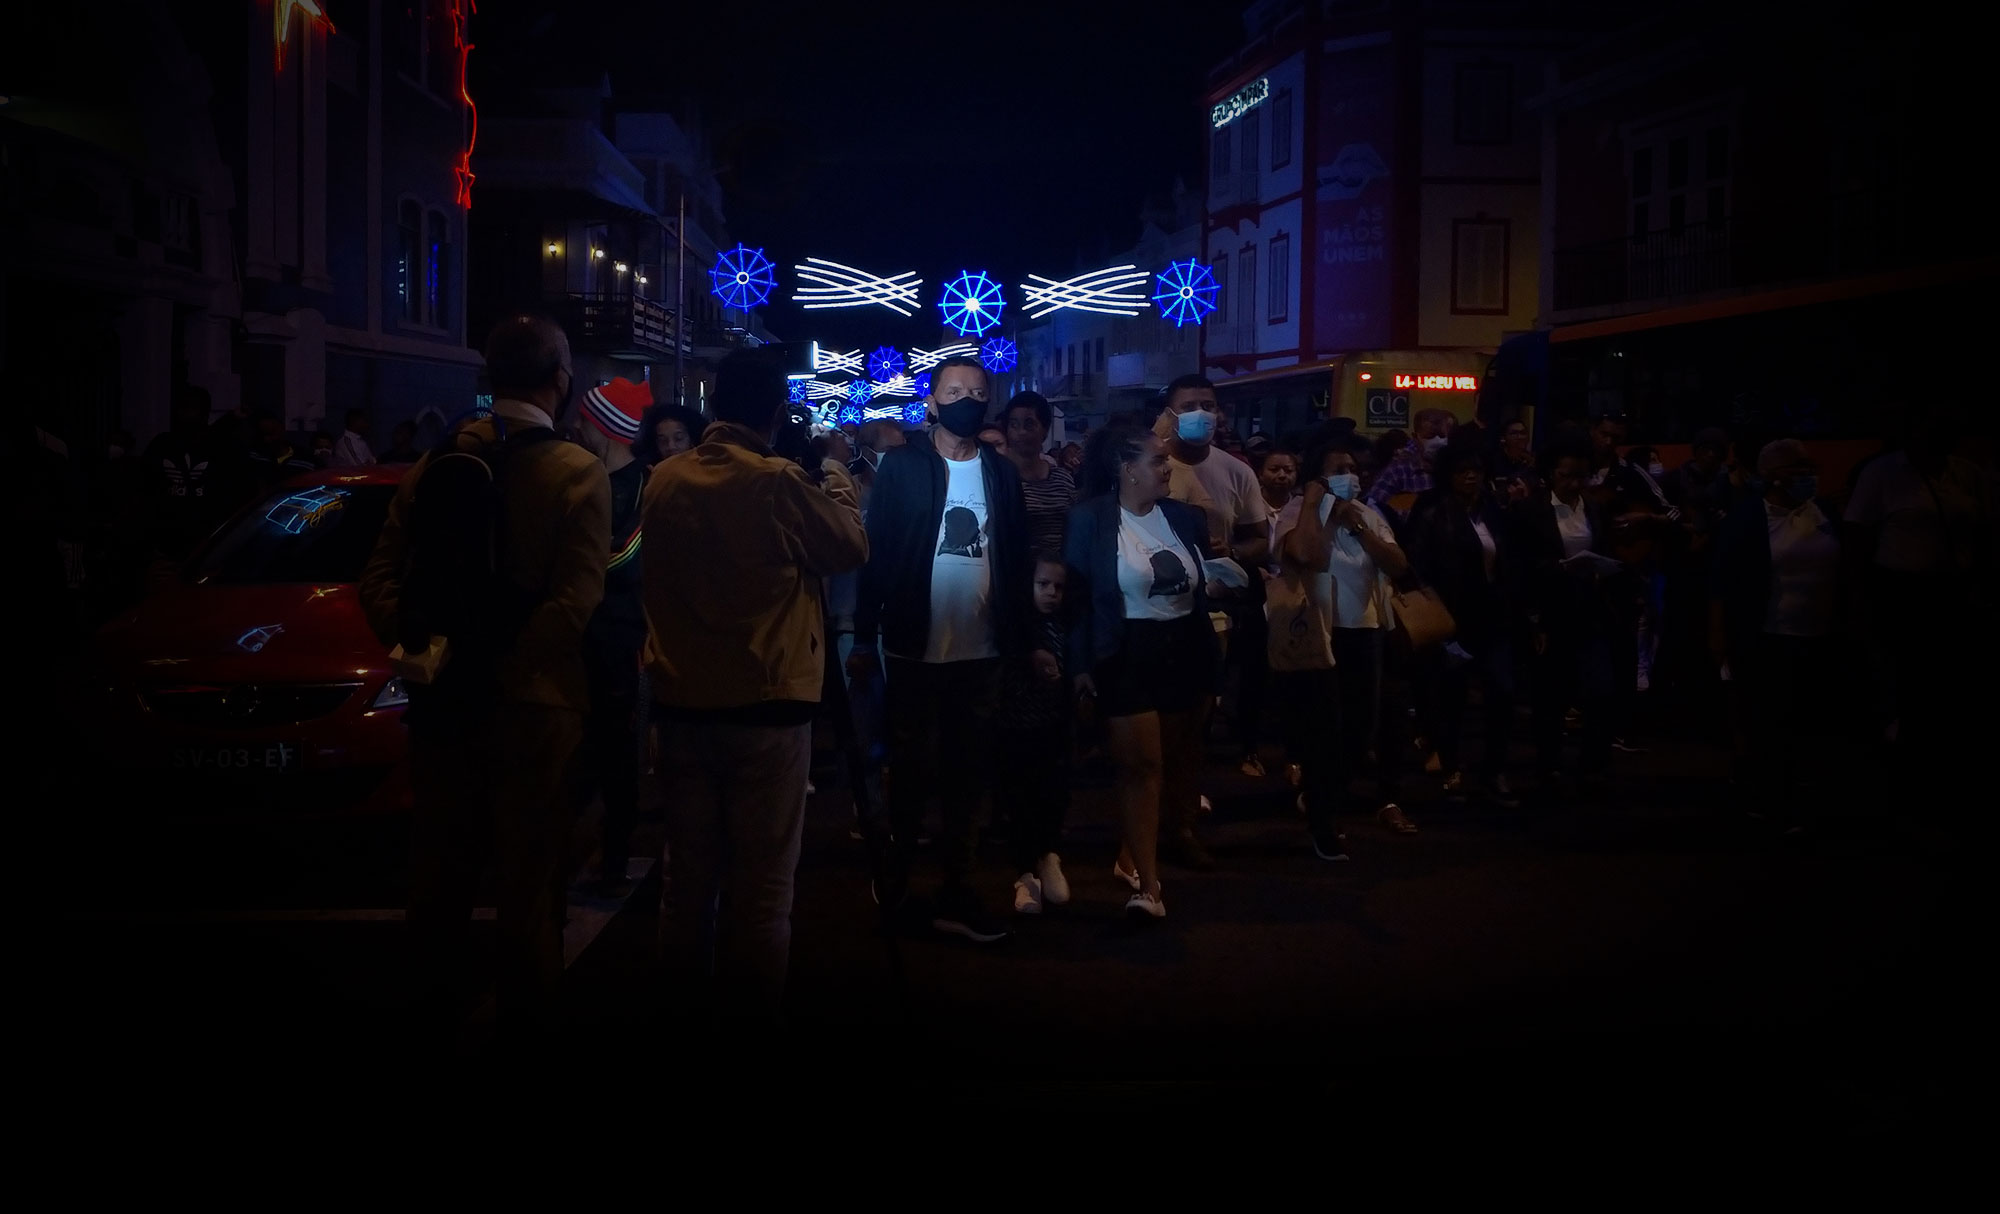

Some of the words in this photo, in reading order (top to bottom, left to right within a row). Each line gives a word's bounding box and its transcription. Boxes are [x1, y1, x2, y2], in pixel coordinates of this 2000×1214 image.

[1358, 205, 1384, 222] AS
[1323, 223, 1384, 243] MÃOS
[1323, 245, 1384, 263] UNEM
[1417, 376, 1453, 389] LICEU
[1454, 377, 1476, 390] VEL
[1368, 391, 1408, 415] CIC
[166, 484, 204, 497] dids
[172, 748, 294, 768] SV-03-EF
